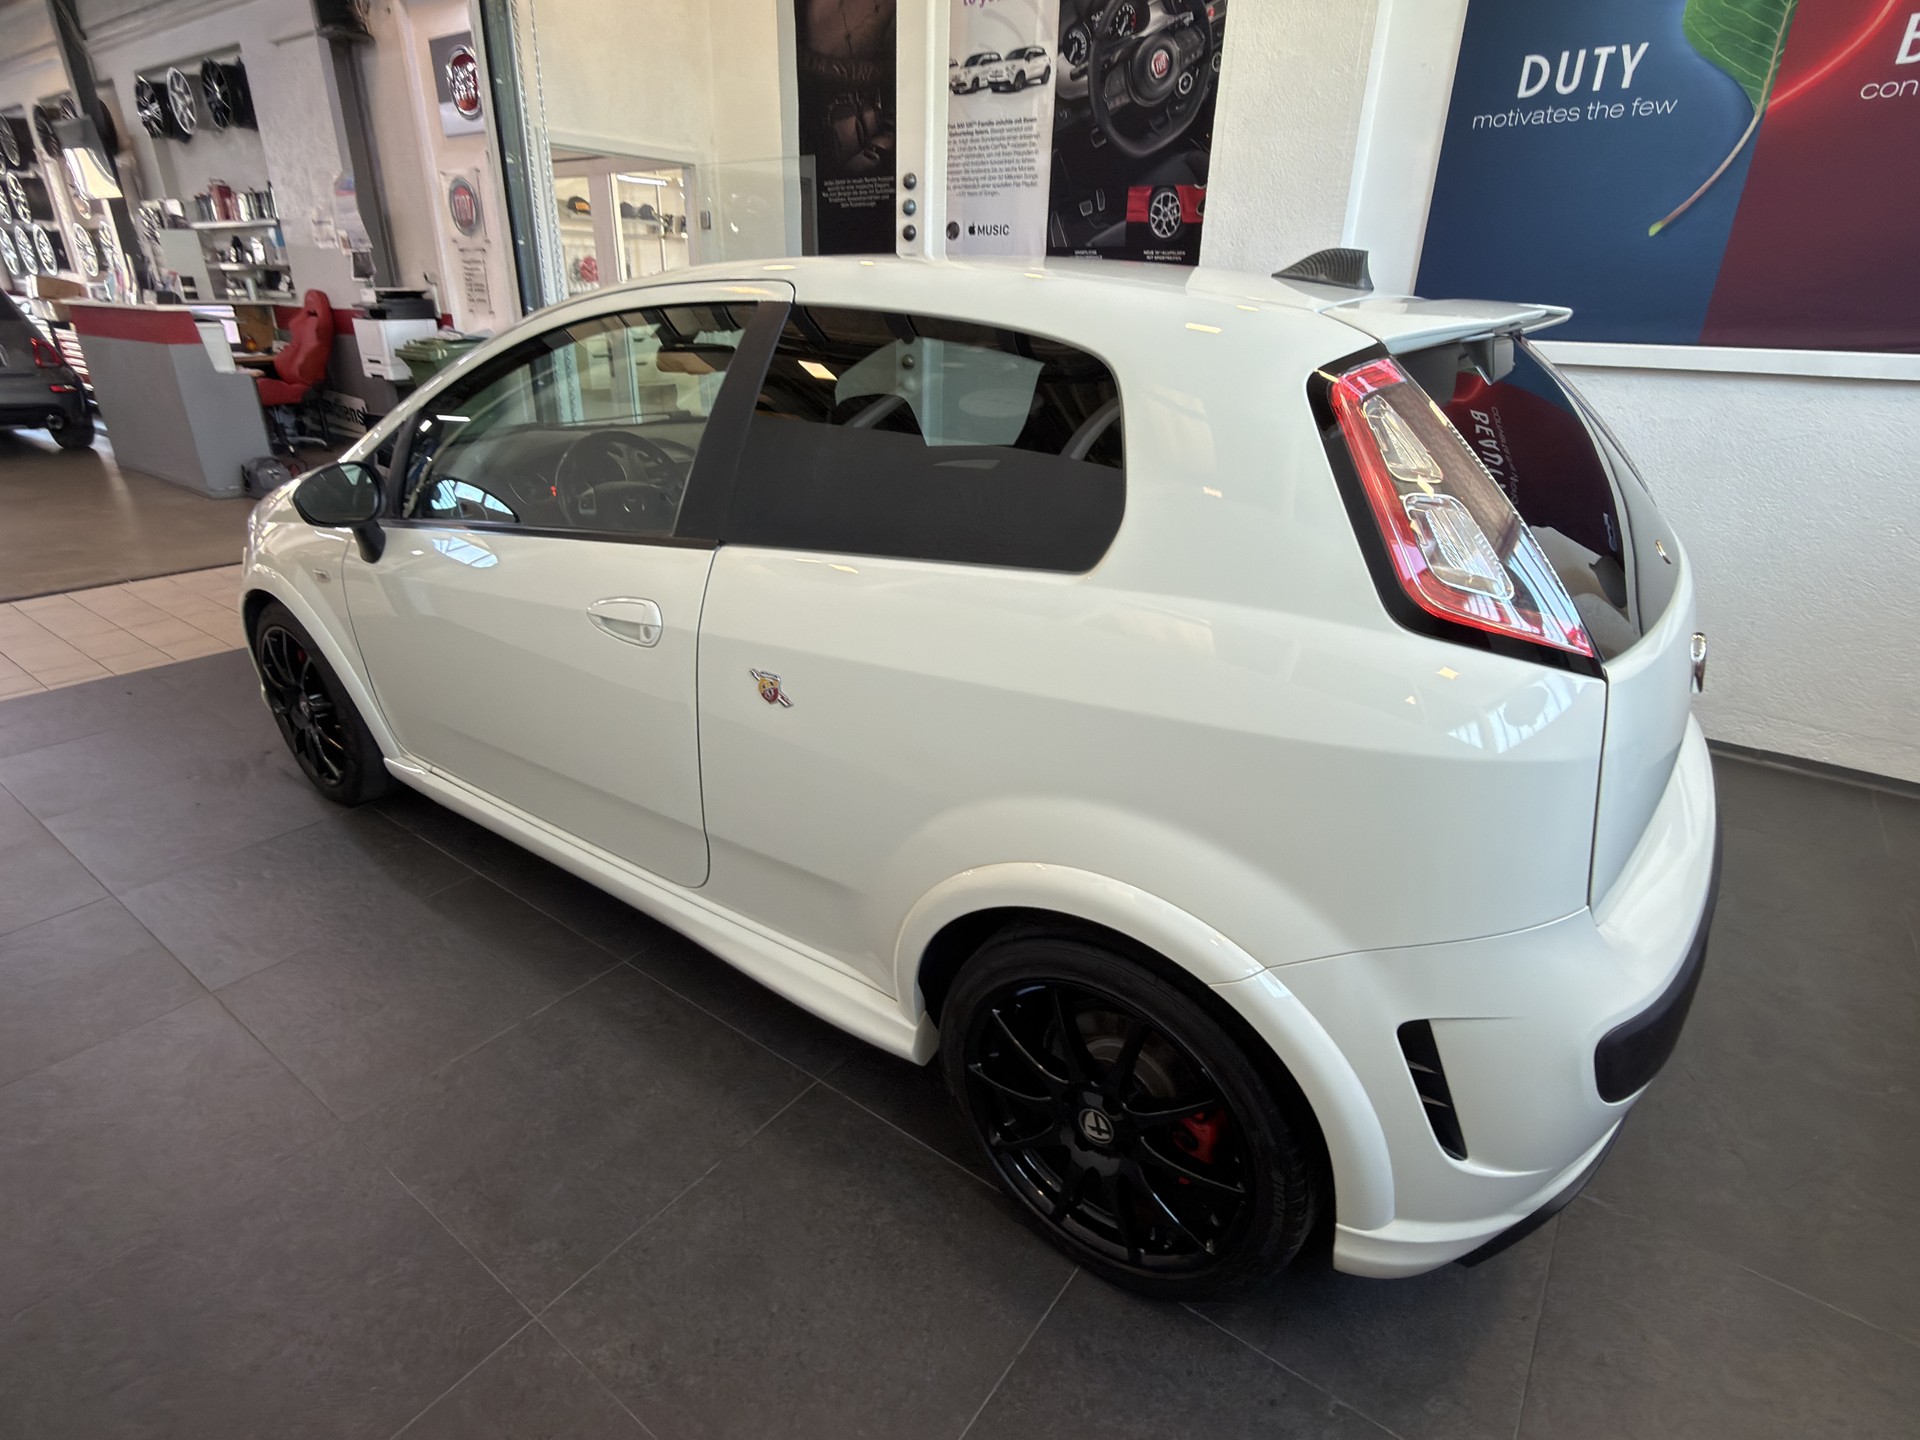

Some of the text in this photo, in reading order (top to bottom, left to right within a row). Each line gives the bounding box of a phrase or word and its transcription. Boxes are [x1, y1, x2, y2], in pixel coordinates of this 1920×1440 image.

[1516, 41, 1650, 99] DUTY
[1472, 97, 1678, 130] motivates the few
[977, 224, 1010, 236] MUSIC
